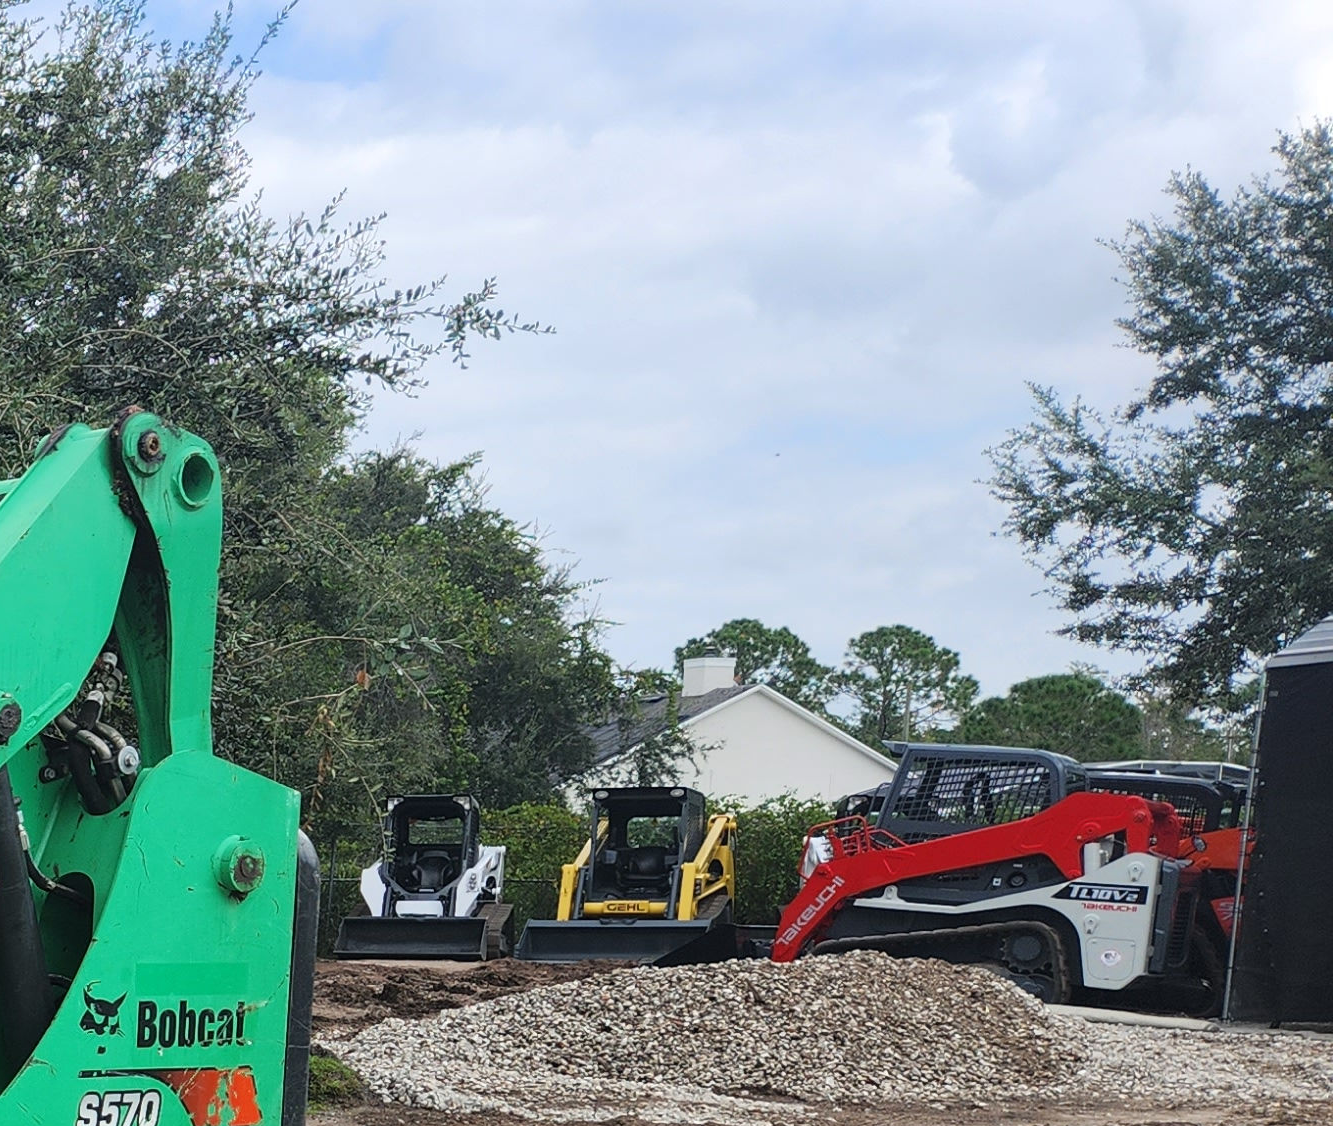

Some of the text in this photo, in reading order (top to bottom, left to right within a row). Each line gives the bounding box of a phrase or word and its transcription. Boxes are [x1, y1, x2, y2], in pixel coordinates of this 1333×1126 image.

[606, 902, 646, 912] GEHL
[1081, 902, 1138, 913] TAKEUCHI
[137, 1000, 246, 1048] Bobcat
